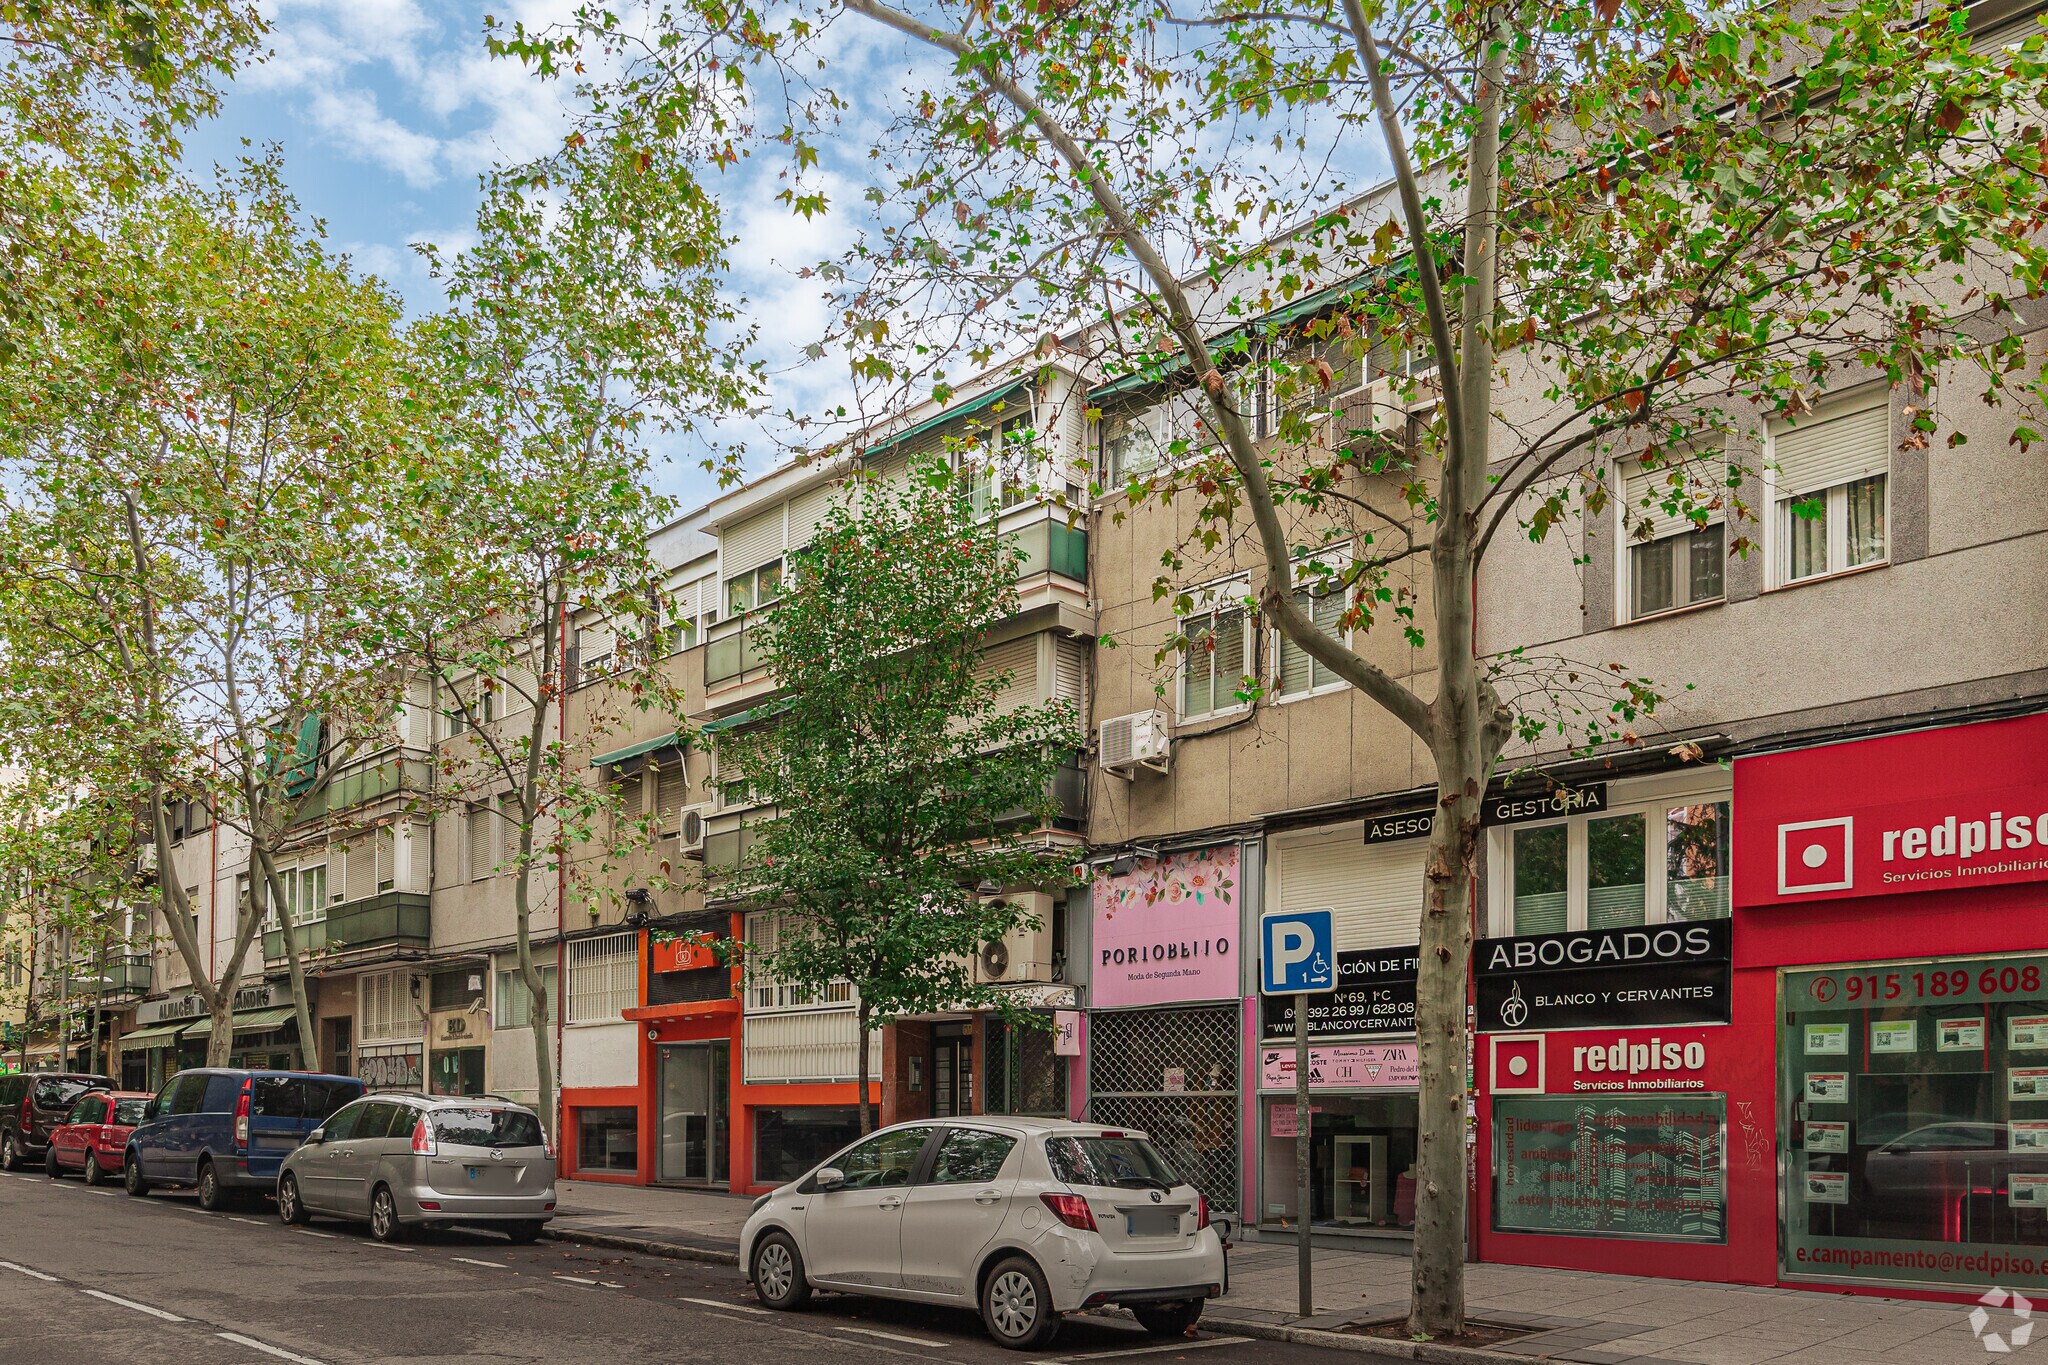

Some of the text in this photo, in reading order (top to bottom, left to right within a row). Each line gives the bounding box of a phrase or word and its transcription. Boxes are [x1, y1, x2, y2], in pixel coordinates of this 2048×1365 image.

[1497, 790, 1599, 819] GESTORÍA
[1883, 868, 1951, 884] Servicios
[1272, 921, 1315, 985] P
[1488, 928, 1711, 970] ABOGADOS
[1380, 959, 1400, 972] DE
[1128, 973, 1144, 981] Moda
[1154, 970, 1181, 980] Segunda
[1183, 968, 1201, 976] Mano
[1846, 965, 2041, 1001] 915 189 608
[1535, 986, 1714, 1007] BLANCO Y CERVANTES
[1332, 1006, 1347, 1017] 26
[1349, 1005, 1364, 1016] 99
[1373, 1003, 1396, 1015] 628
[1398, 1002, 1414, 1013] 08
[1383, 1049, 1407, 1061] ZARA
[1573, 1037, 1706, 1075] redpiso
[1336, 1066, 1352, 1078] CH
[1406, 1065, 1414, 1073] del
[1573, 1078, 1705, 1091] Servicios Inmobiliarios
[1505, 1117, 1515, 1186] honestidad
